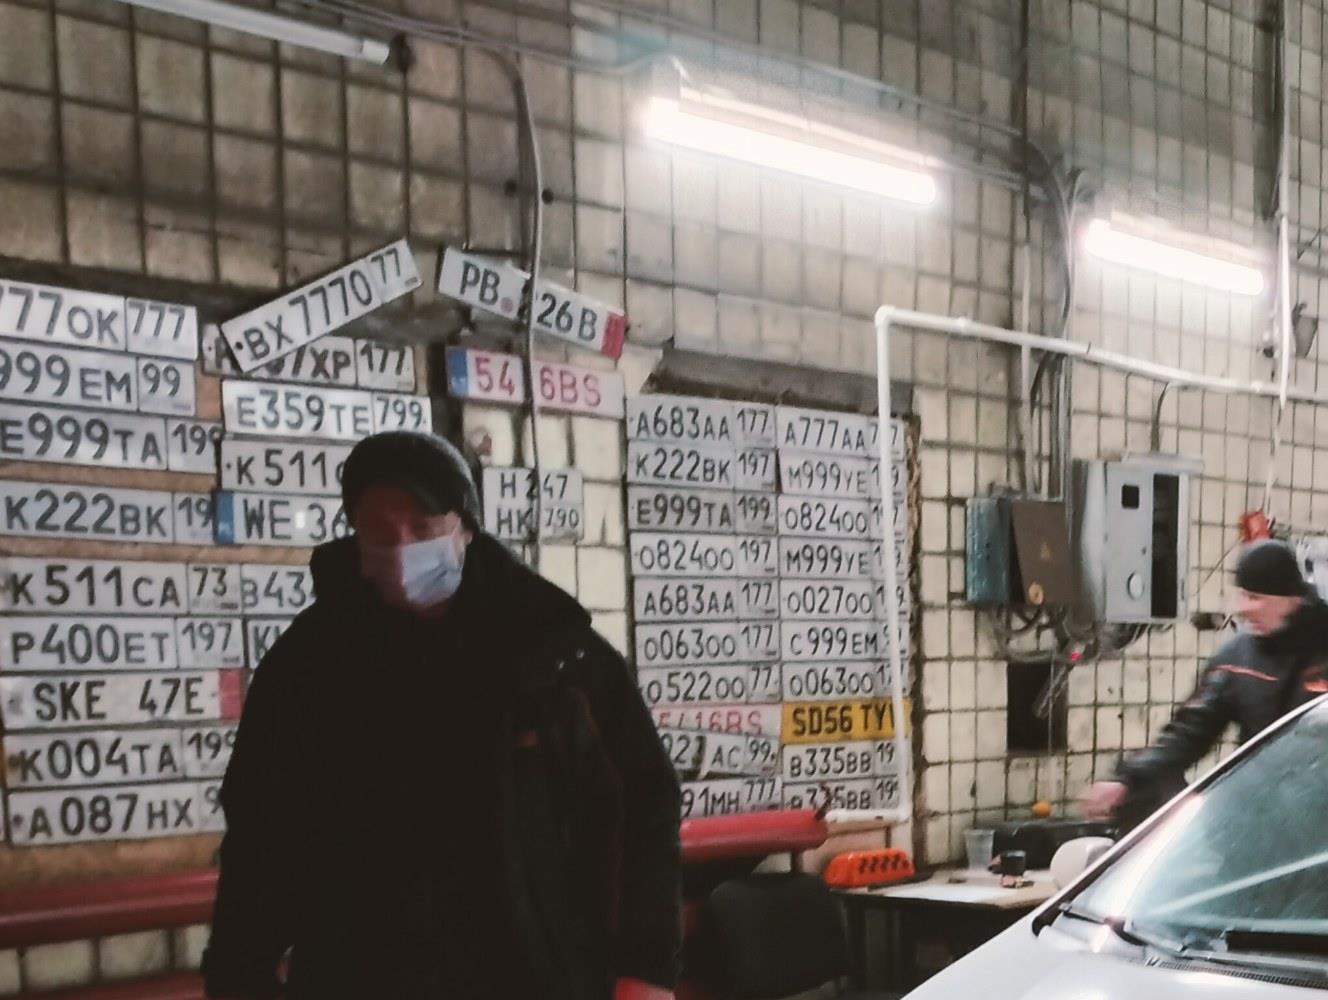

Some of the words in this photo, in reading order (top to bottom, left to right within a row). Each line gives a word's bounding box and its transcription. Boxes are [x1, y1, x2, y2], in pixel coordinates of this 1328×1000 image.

[128, 303, 186, 340] 777
[142, 362, 181, 397] 99
[237, 389, 370, 436] Е359ТЕ
[377, 397, 423, 426] 799
[636, 405, 730, 441] А683АА
[737, 409, 769, 434] 177
[0, 412, 162, 464] Е999ТА
[785, 416, 865, 450] А777АА
[867, 422, 898, 446] 77
[636, 448, 730, 483] К222ВК
[738, 452, 769, 477] 197
[5, 489, 167, 538] К222ВК
[178, 497, 213, 528] 19
[243, 499, 291, 539] WE
[637, 493, 732, 527] Е999ТА
[737, 495, 770, 521] 199
[740, 539, 771, 563] 197
[10, 564, 180, 608] К511СА
[192, 567, 228, 597] 73
[241, 570, 316, 608] В43
[644, 583, 735, 616] А683АА
[741, 582, 772, 606] 177
[11, 623, 170, 665] Р400ЕТ
[182, 621, 232, 652] 197
[741, 624, 773, 649] 177
[751, 666, 772, 691] 77
[33, 680, 107, 722] SKE
[792, 705, 853, 736] SD56
[20, 737, 178, 782] К004ТА
[790, 746, 871, 778] В335ВВ
[877, 742, 895, 764] 19
[28, 793, 193, 839] А087НХ
[680, 786, 740, 818] 91МН
[745, 778, 776, 802] 777
